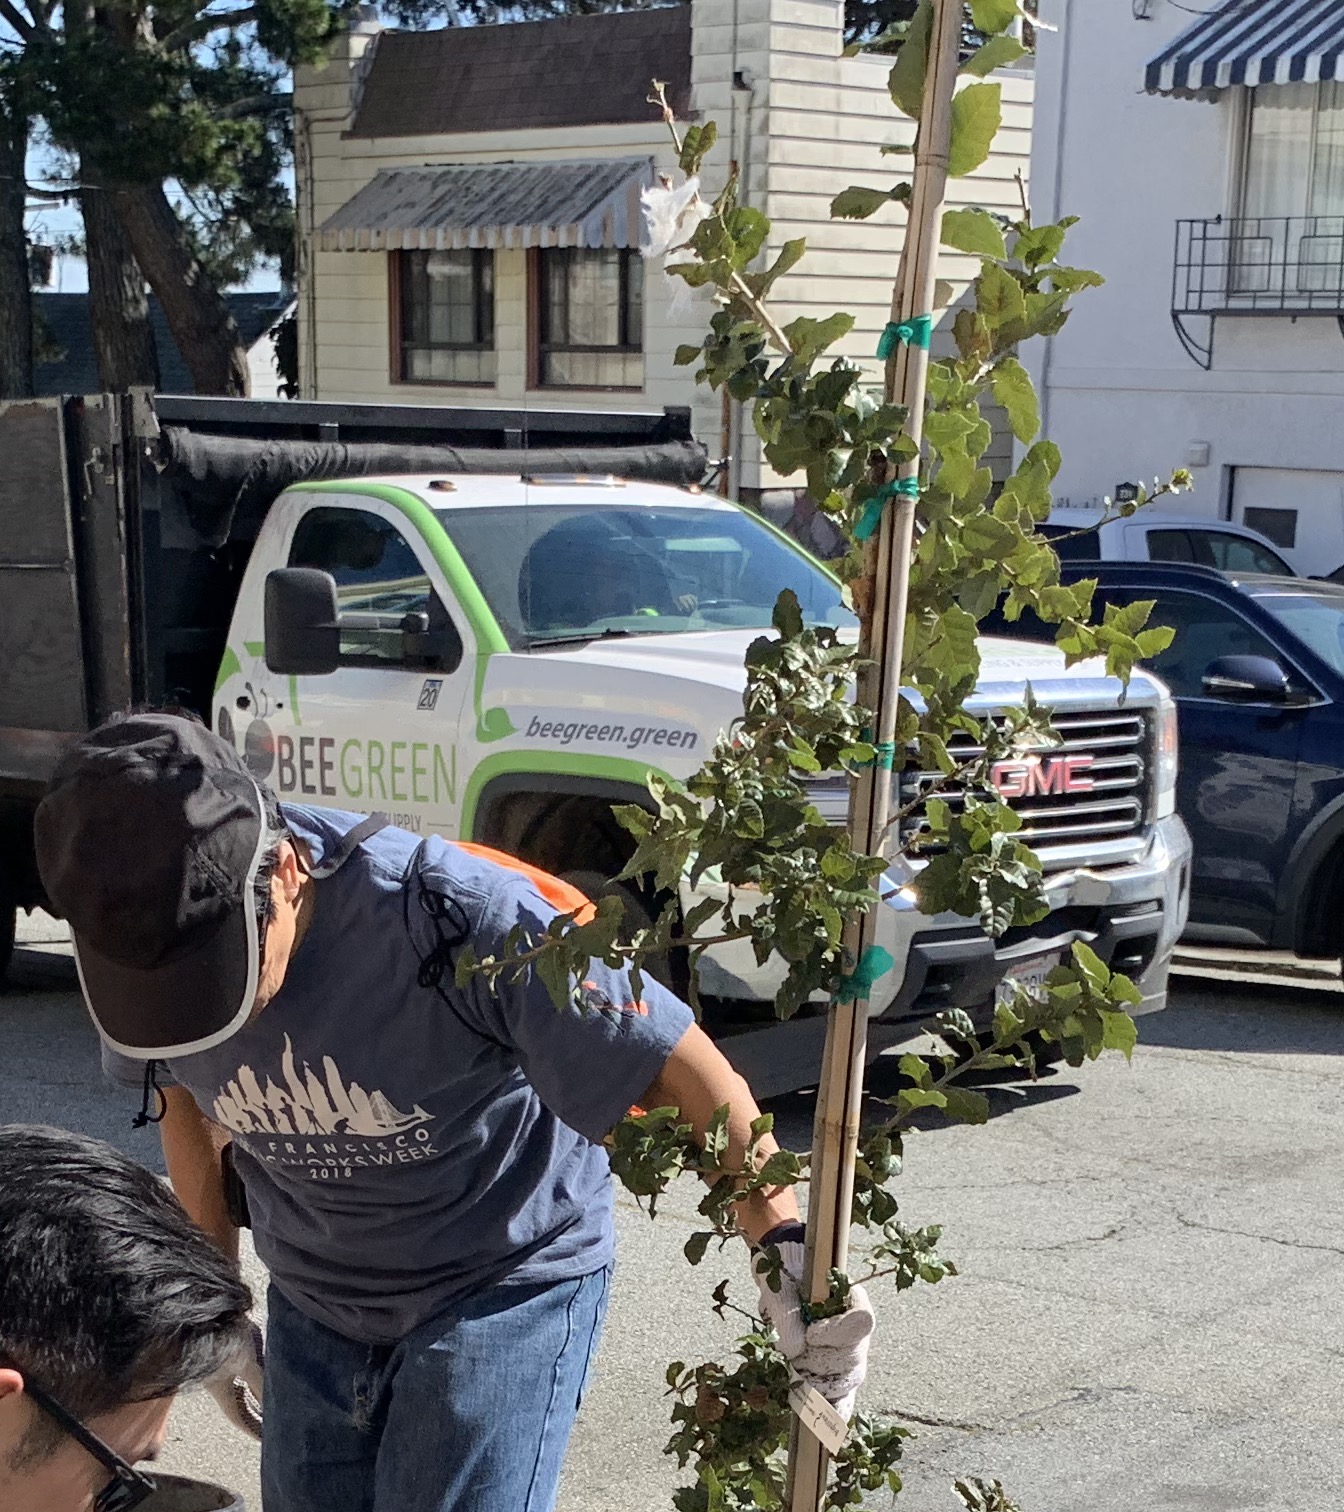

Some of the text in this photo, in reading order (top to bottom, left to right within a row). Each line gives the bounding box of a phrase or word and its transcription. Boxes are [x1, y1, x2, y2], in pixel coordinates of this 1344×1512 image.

[419, 688, 437, 708] 20
[525, 715, 698, 749] beegreen.green
[268, 1128, 430, 1154] FRANCISCO
[370, 1143, 439, 1166] WEEK
[309, 1167, 352, 1179] 2018
